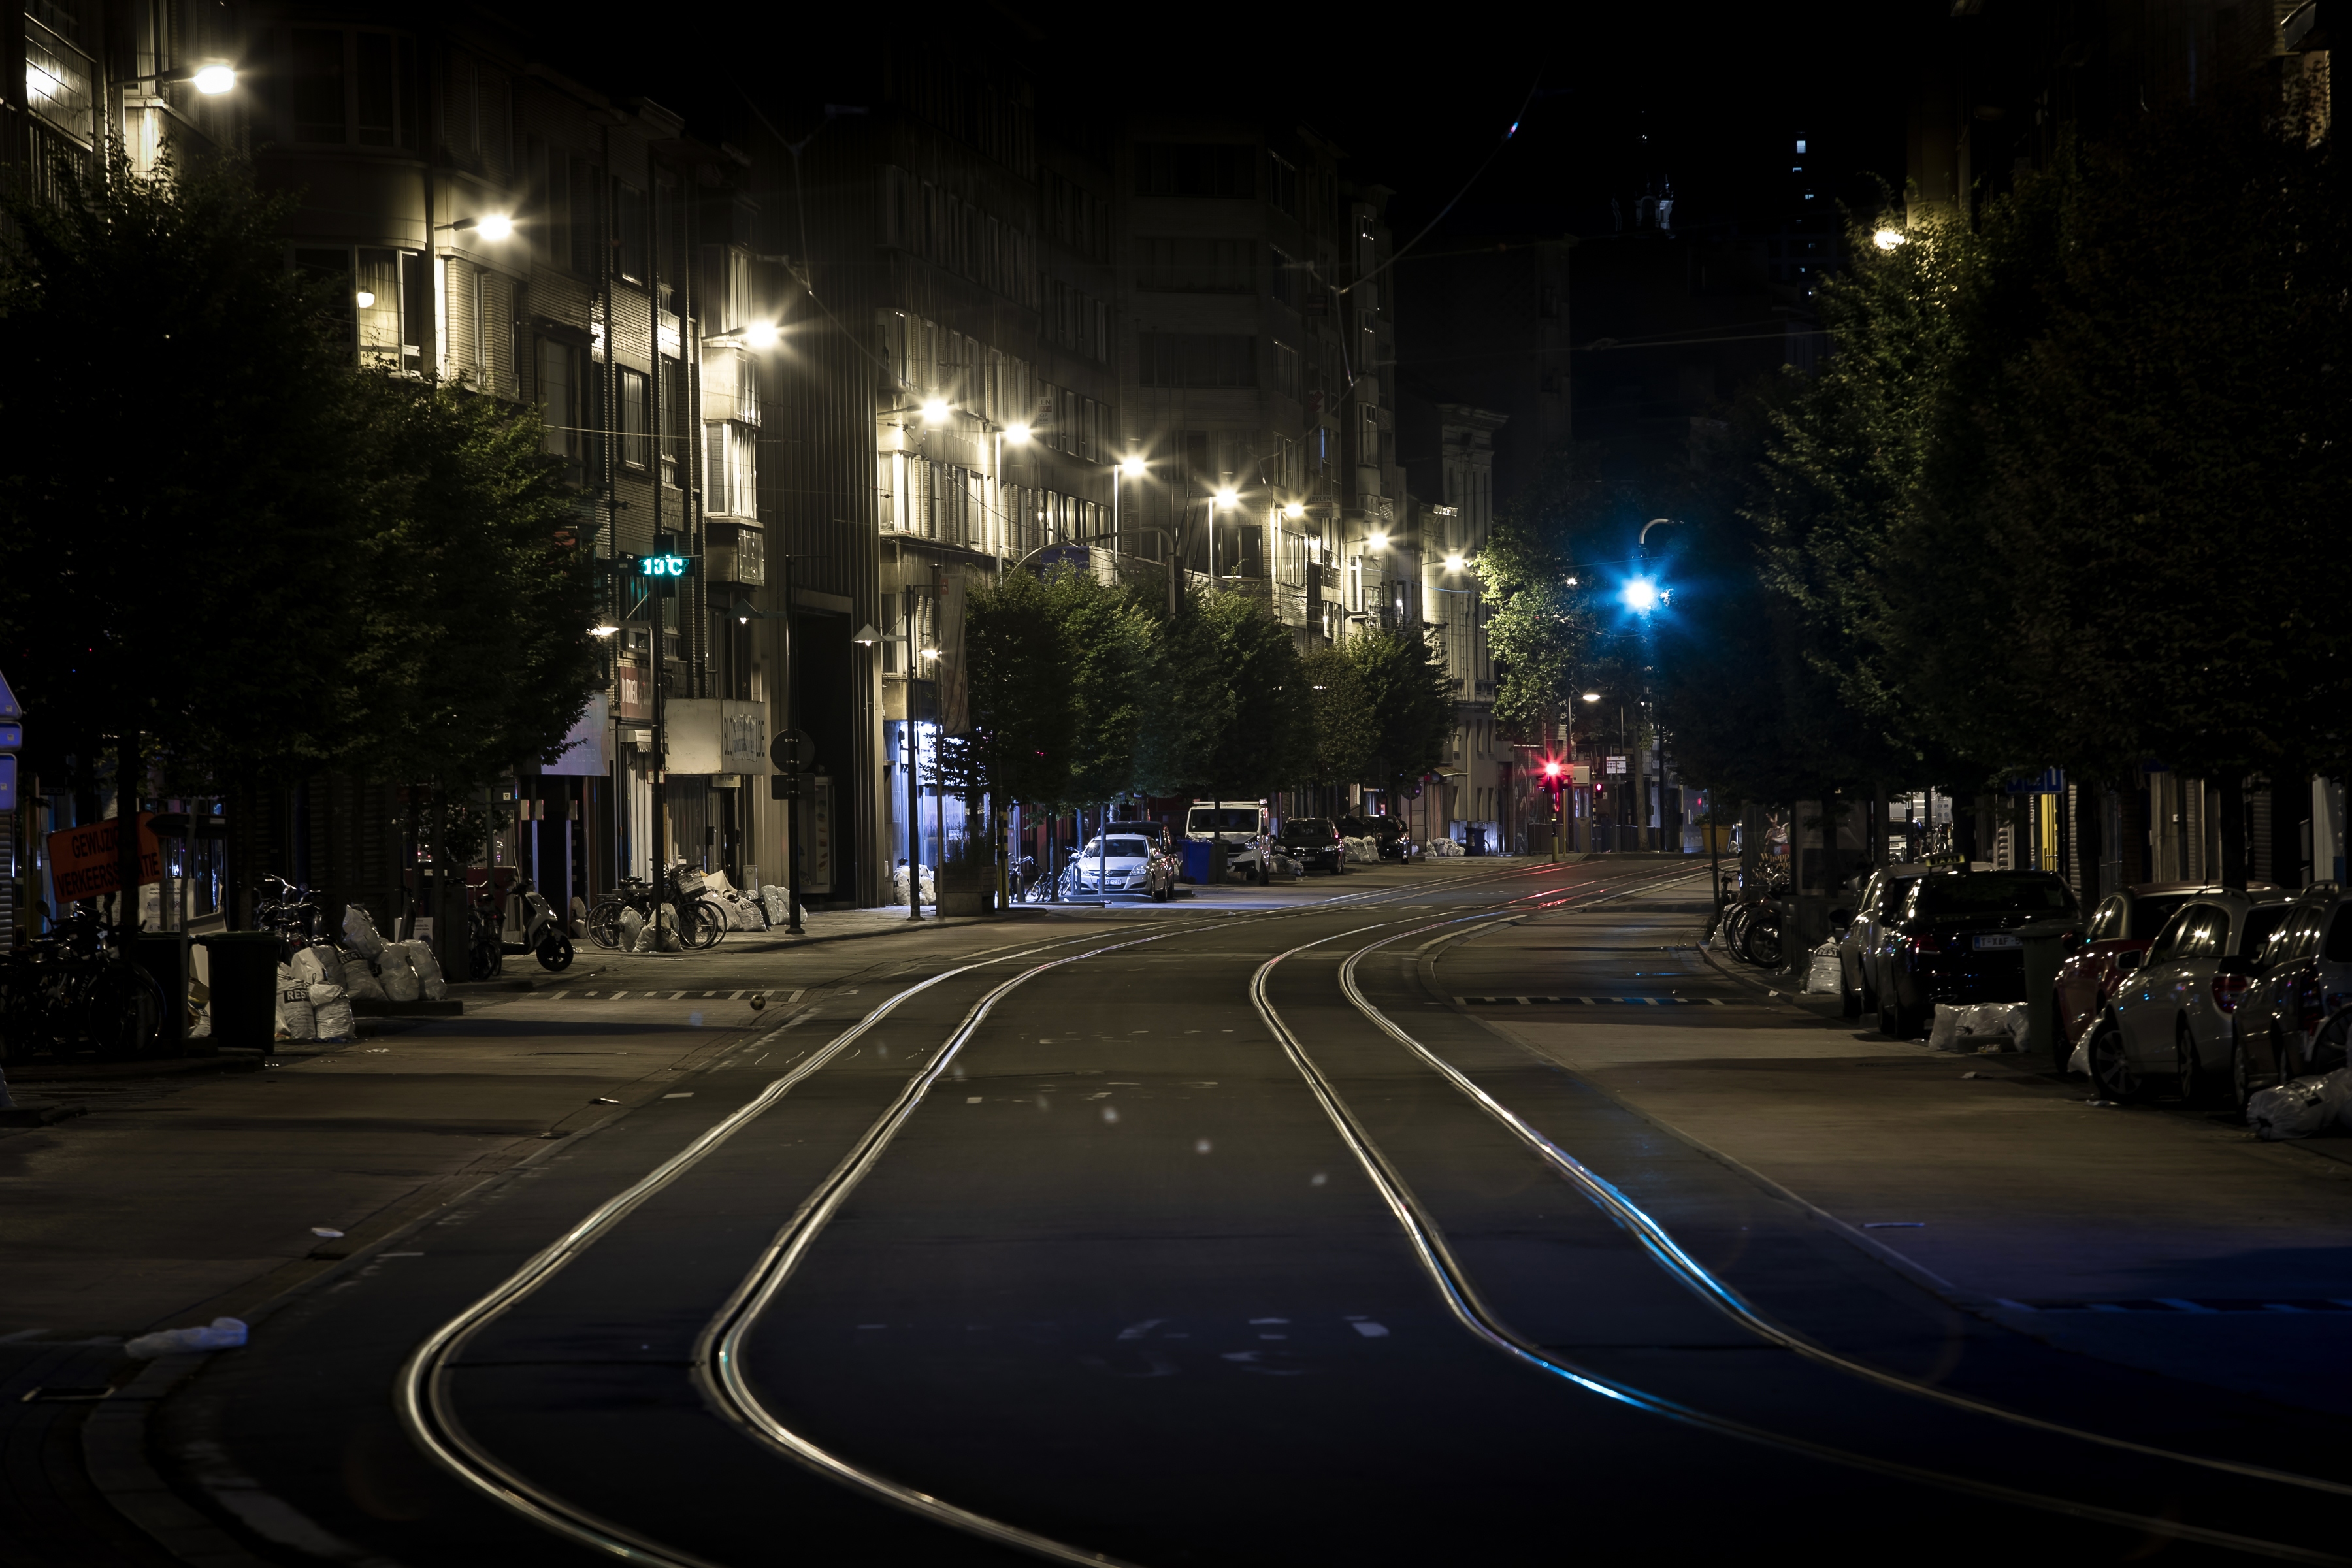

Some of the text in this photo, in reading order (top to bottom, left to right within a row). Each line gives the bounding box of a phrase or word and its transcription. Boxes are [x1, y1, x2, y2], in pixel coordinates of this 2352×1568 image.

[1935, 856, 1957, 864] TAXI
[57, 852, 160, 897] VERKEERSSATIE
[1981, 936, 2022, 946] T-XAF-5
[1817, 948, 1838, 956] REST
